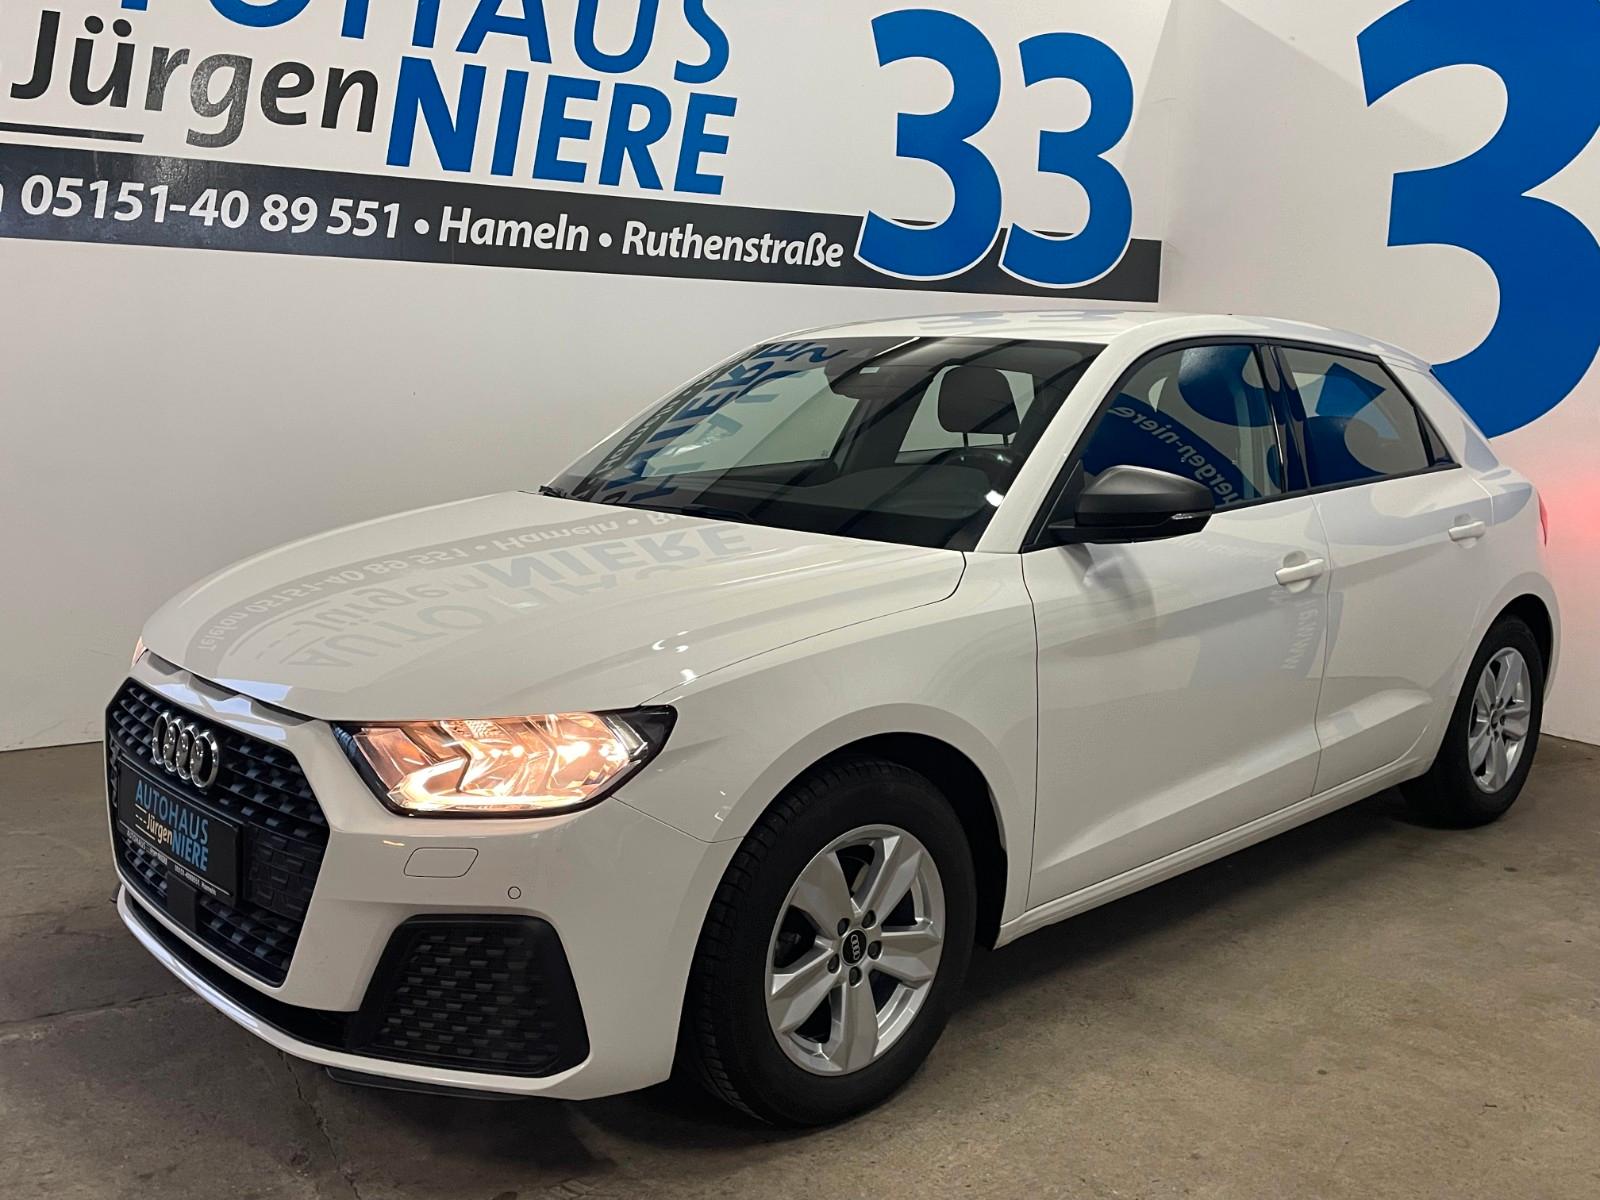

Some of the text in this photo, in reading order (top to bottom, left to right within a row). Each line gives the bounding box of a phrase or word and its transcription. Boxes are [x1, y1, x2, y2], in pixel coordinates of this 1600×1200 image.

[120, 0, 730, 84] AUS
[9, 9, 737, 195] Jürgen NIERE
[20, 174, 249, 230] 05151-40
[259, 193, 317, 234] 89
[326, 197, 401, 239] 551
[438, 205, 588, 252] Hameln
[621, 219, 844, 268] Ruthenstraße
[135, 779, 209, 845] AUTOHAUS
[147, 812, 173, 844] Jürgen
[171, 830, 209, 872] NIERE
